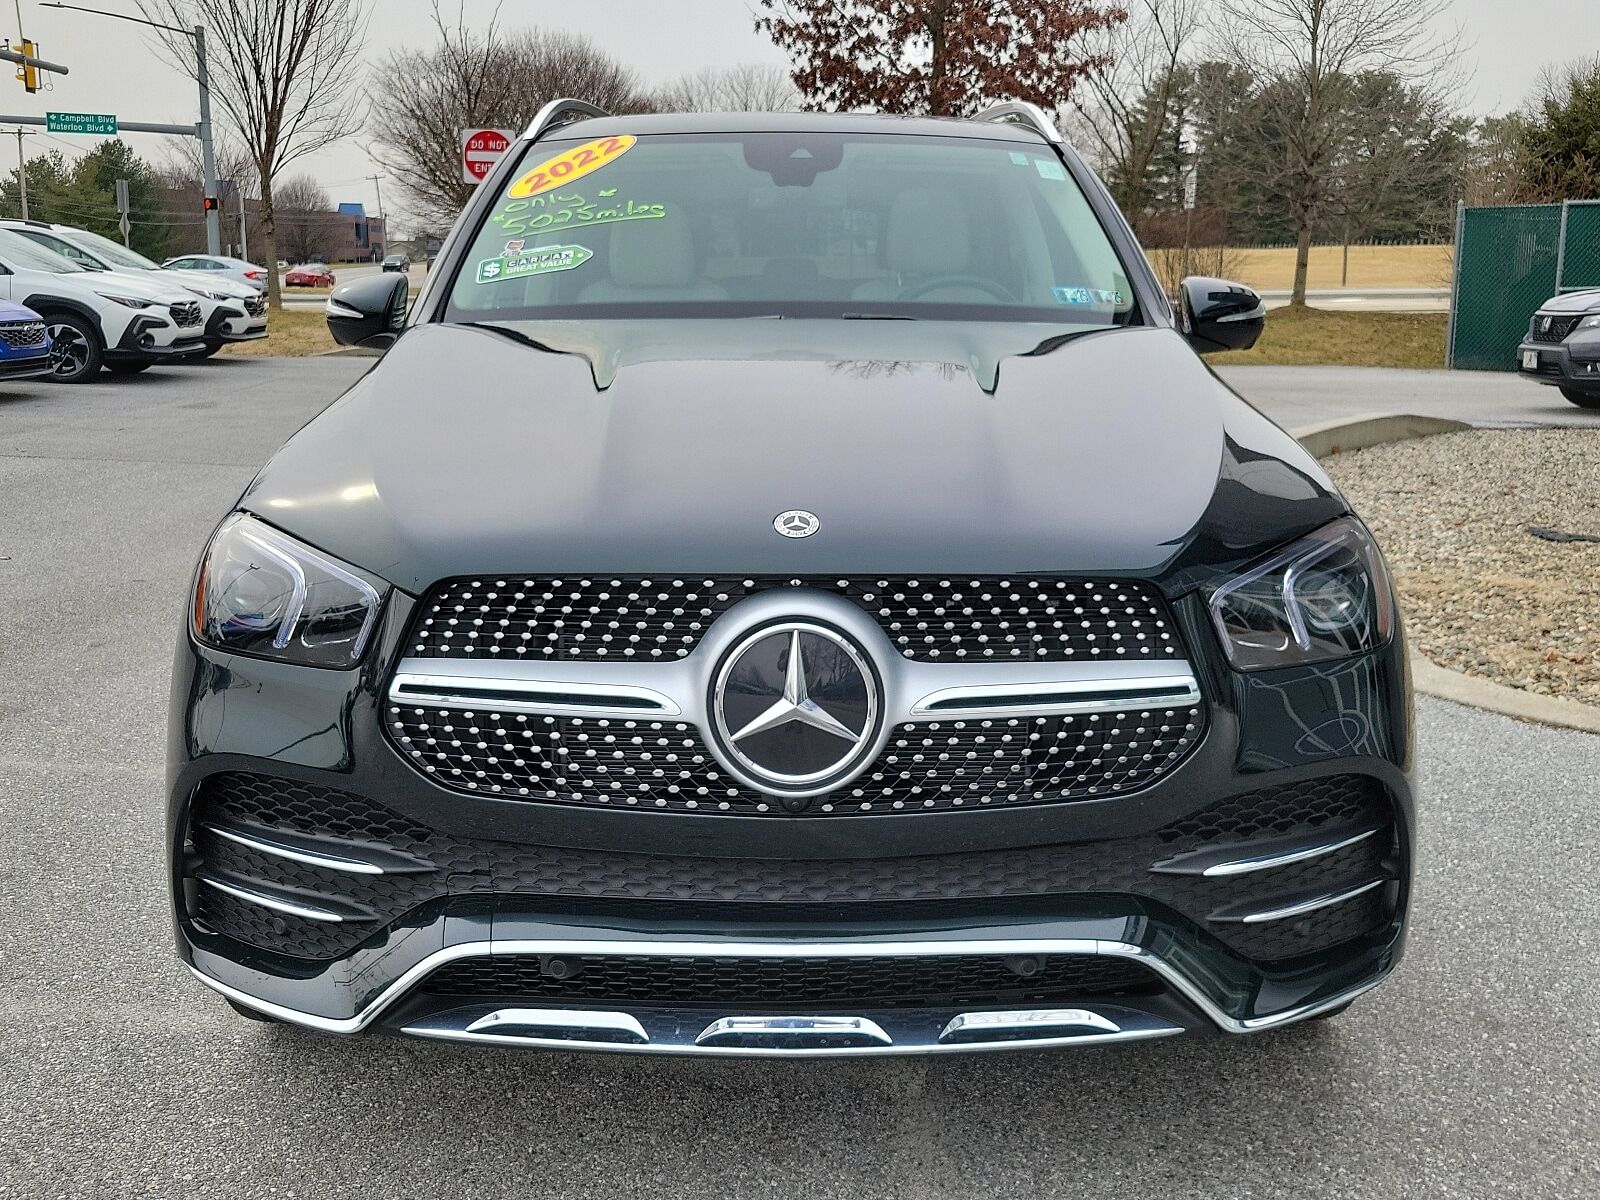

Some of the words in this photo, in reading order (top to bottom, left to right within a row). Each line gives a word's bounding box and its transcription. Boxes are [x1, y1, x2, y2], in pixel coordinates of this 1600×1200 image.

[60, 114, 94, 123] Campbell
[98, 115, 115, 124] Blvd
[49, 122, 83, 131] Waterloo
[87, 124, 105, 132] Blvd
[471, 140, 484, 150] DO
[488, 140, 507, 150] NOT
[525, 138, 625, 193] 2022
[507, 250, 575, 268] CARFAX
[506, 263, 539, 274] GREAT
[541, 258, 573, 268] VALUE
